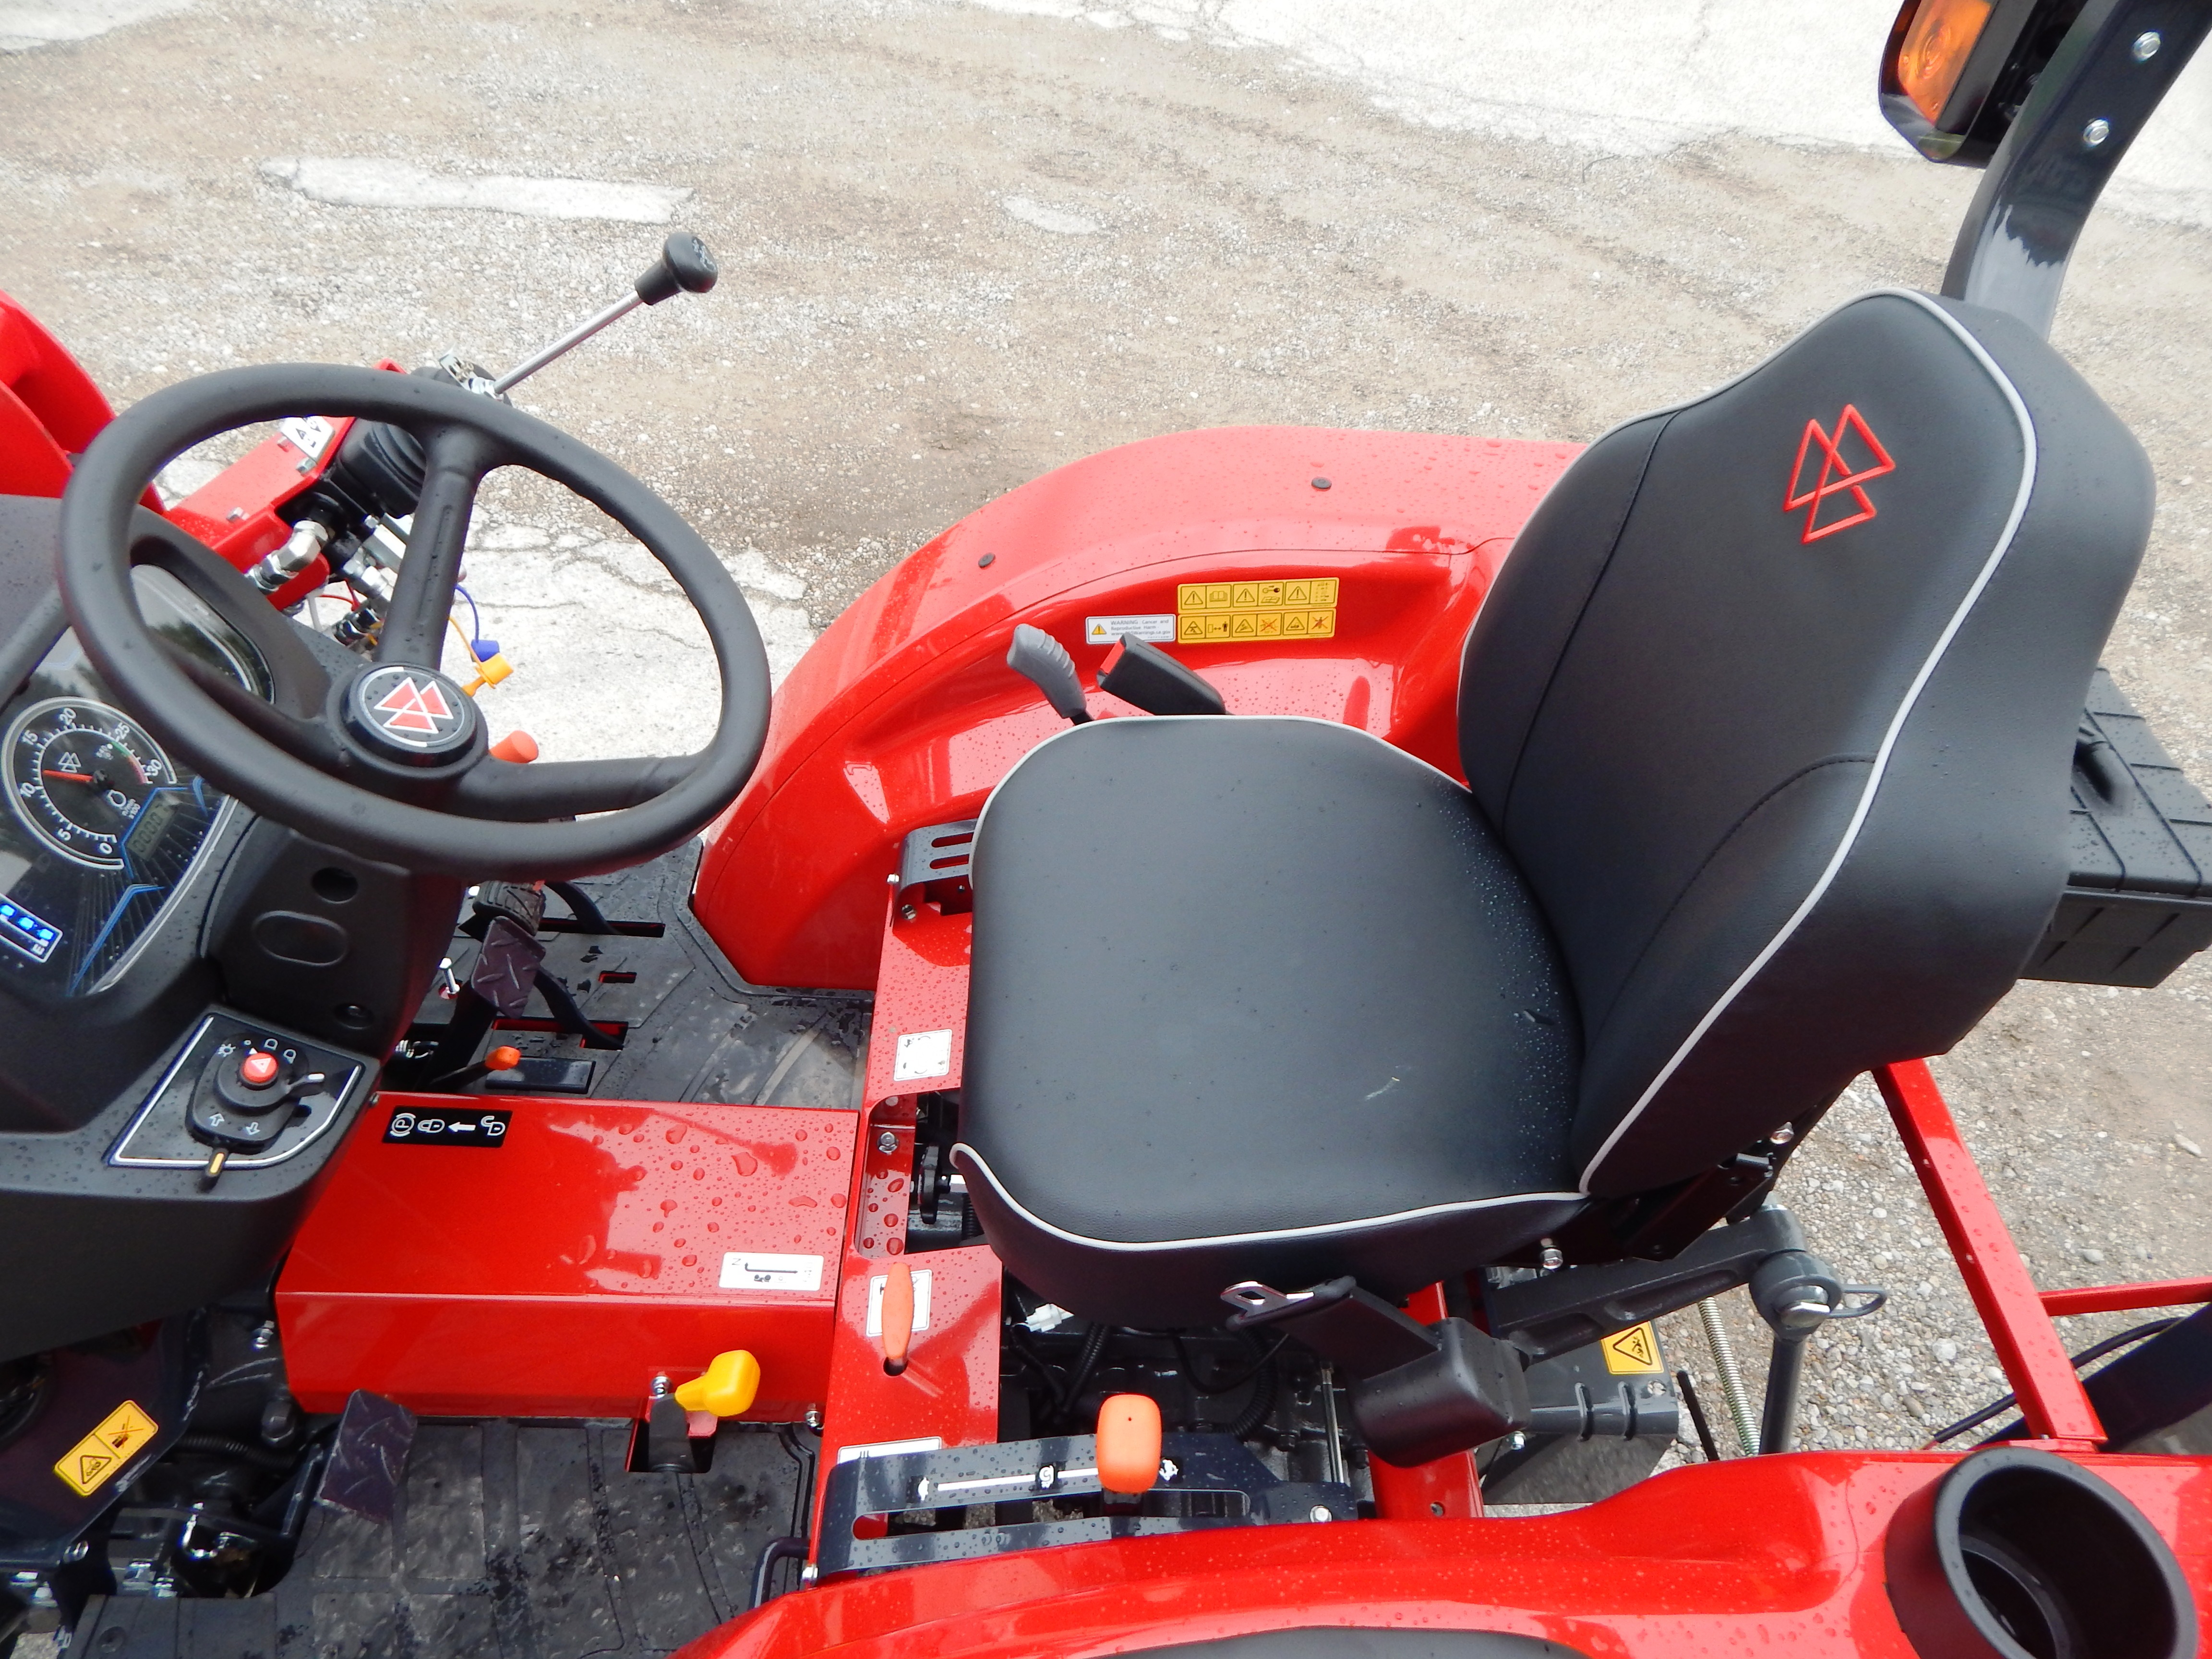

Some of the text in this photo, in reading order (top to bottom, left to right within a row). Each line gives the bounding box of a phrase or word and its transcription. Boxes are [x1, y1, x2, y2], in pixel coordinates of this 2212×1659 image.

[60, 708, 76, 725] 20
[22, 730, 38, 745] 15
[115, 722, 130, 739] 25
[146, 759, 162, 776] 30
[20, 782, 36, 798] 10
[57, 828, 72, 841] 5
[99, 842, 113, 855] 0
[32, 943, 45, 956] E
